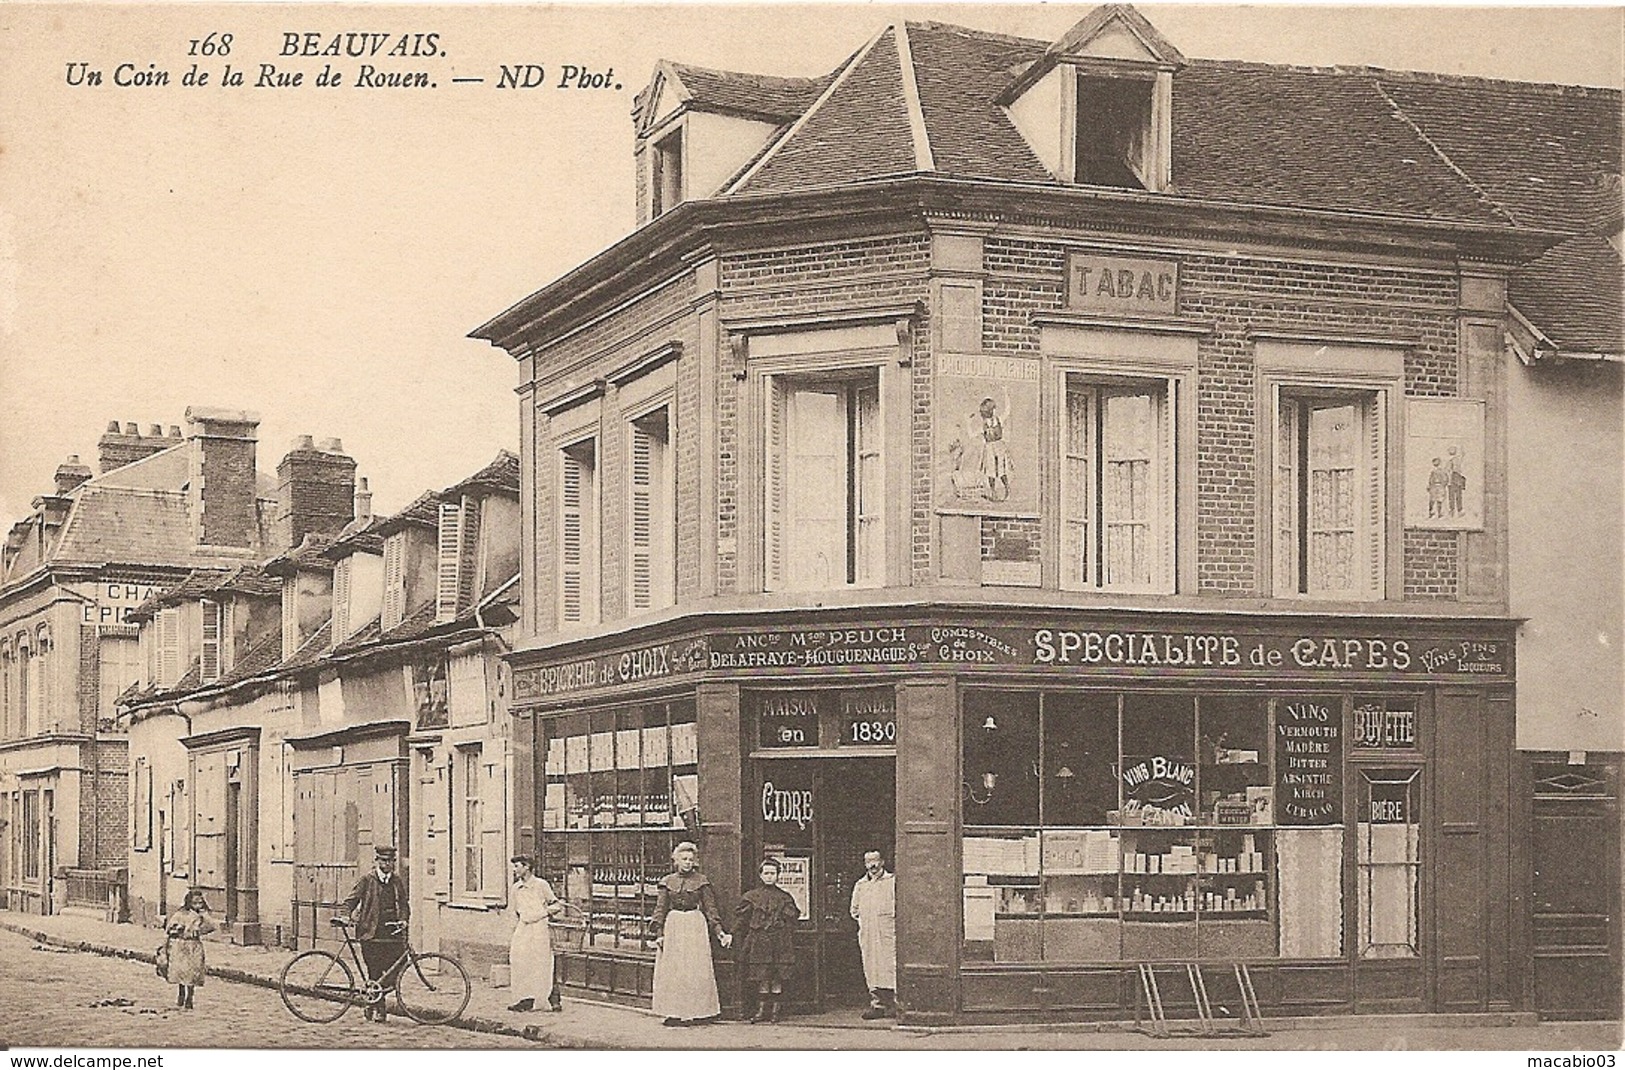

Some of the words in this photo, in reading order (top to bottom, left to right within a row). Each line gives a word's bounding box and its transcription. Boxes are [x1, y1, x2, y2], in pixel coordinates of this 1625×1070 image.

[1075, 265, 1173, 301] TABAC
[108, 584, 170, 601] CHA
[827, 628, 906, 646] PEUCH
[953, 638, 967, 649] de
[939, 644, 996, 661] CHOIX
[1249, 643, 1283, 667] de
[1419, 647, 1457, 674] VINS
[1460, 641, 1497, 659] FINS
[600, 664, 615, 684] de
[618, 644, 670, 681] CHOIX
[763, 698, 817, 716] MAISON
[1286, 702, 1330, 722] VINS
[781, 729, 805, 742] en
[850, 721, 896, 741] 1830
[1278, 724, 1338, 738] VERMOUTH
[1353, 709, 1414, 743] BUVETTE
[1122, 762, 1150, 787] VINS
[1151, 756, 1195, 785] BLANC
[1289, 756, 1328, 769] BITTER
[1281, 773, 1333, 785] ABSINTHE
[1293, 787, 1325, 799] KIRCH
[762, 782, 815, 830] CIDRE
